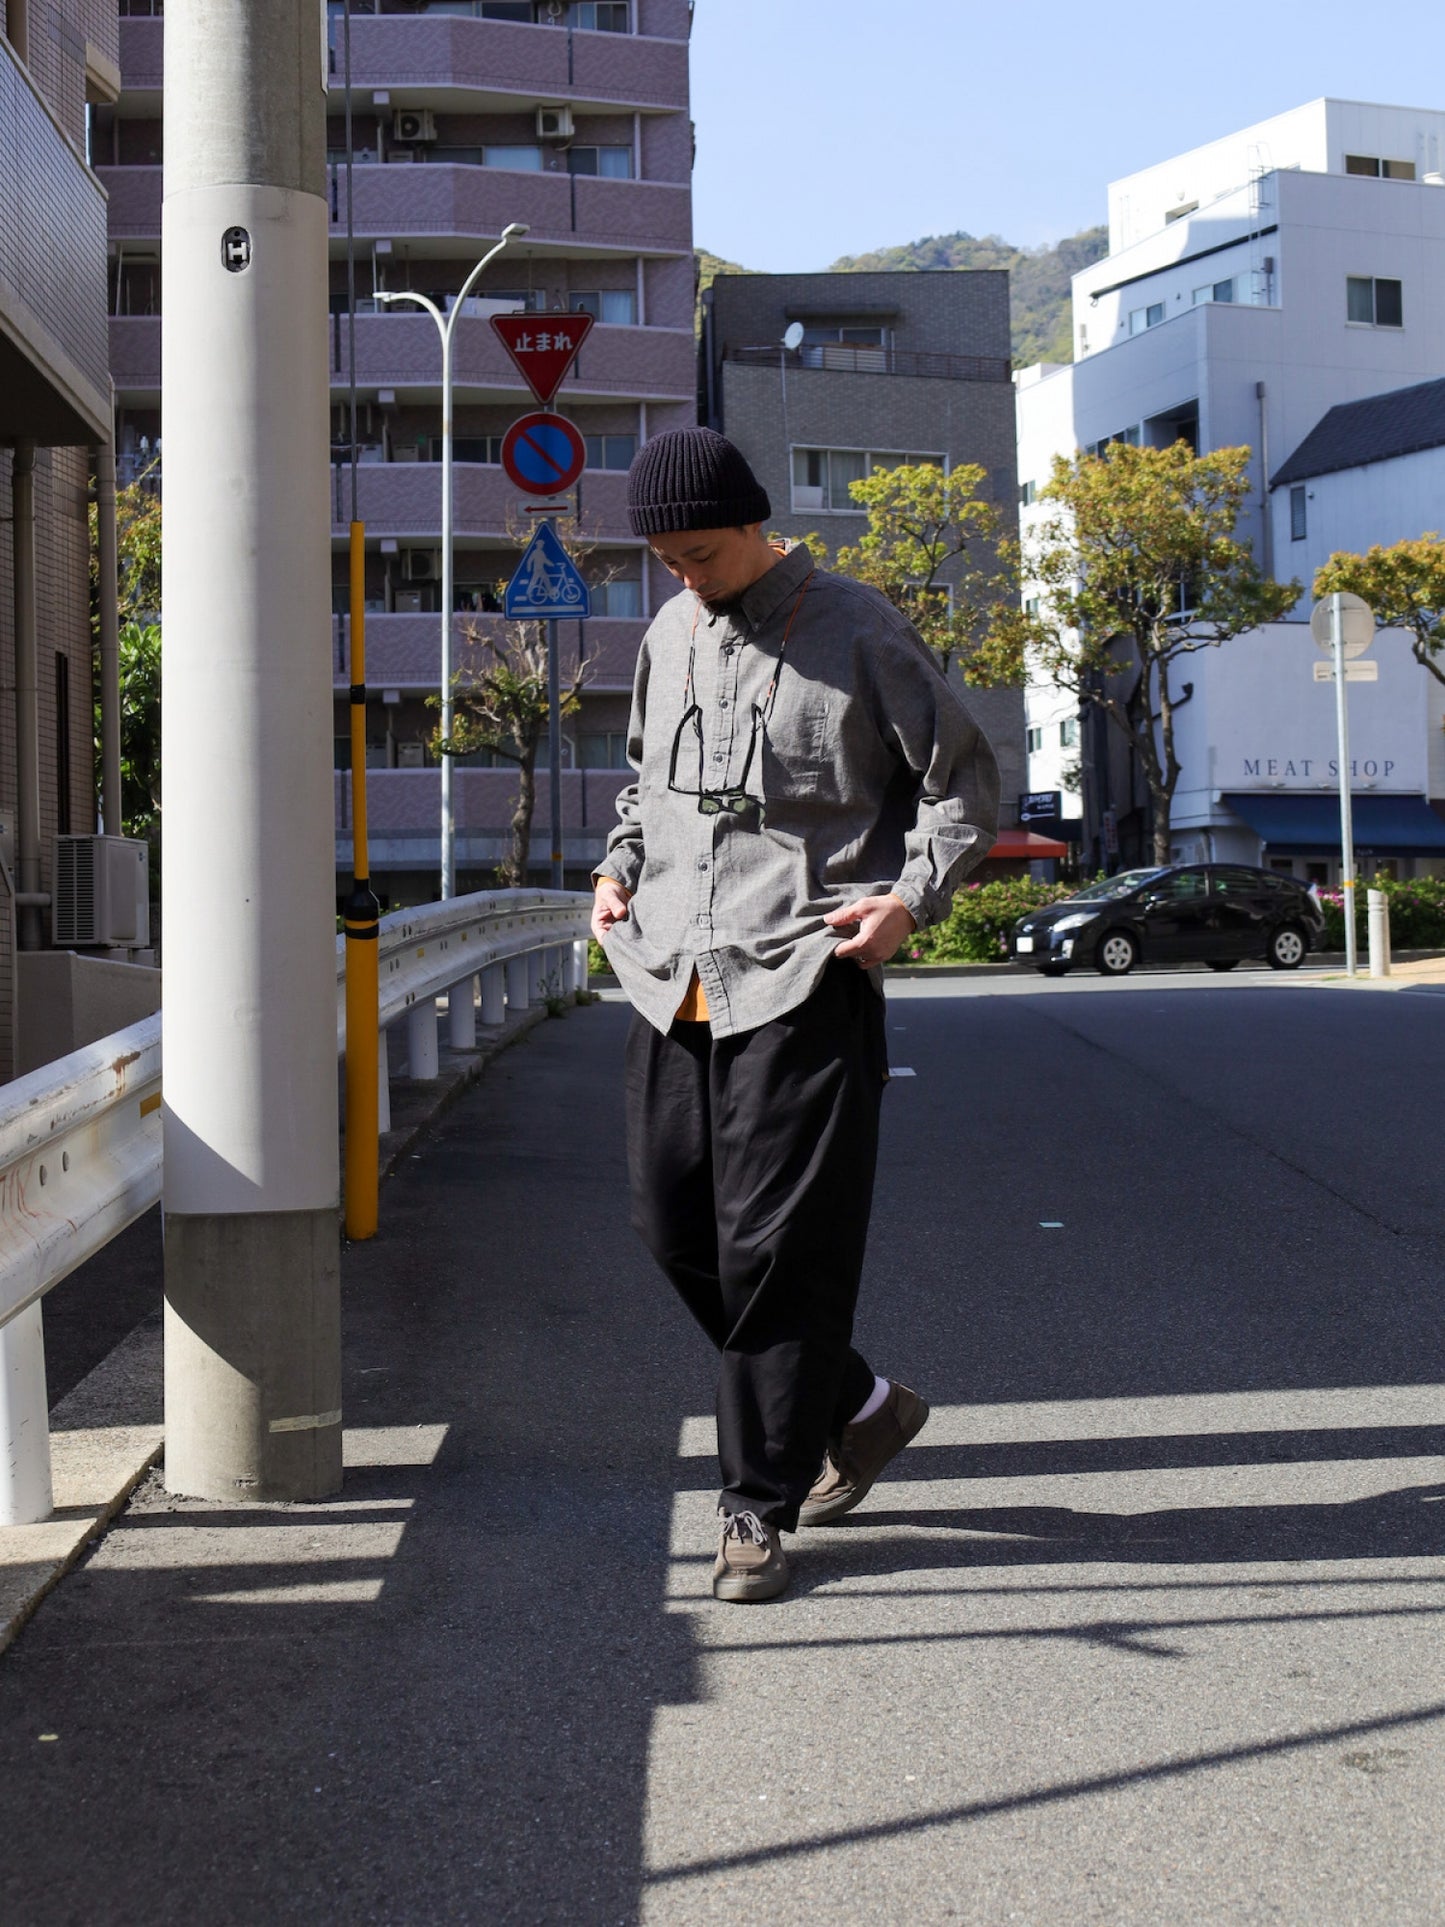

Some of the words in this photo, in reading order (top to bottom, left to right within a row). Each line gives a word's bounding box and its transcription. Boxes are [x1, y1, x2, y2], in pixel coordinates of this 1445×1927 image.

[514, 332, 573, 352] 止まれ
[1243, 759, 1312, 777] MEAT
